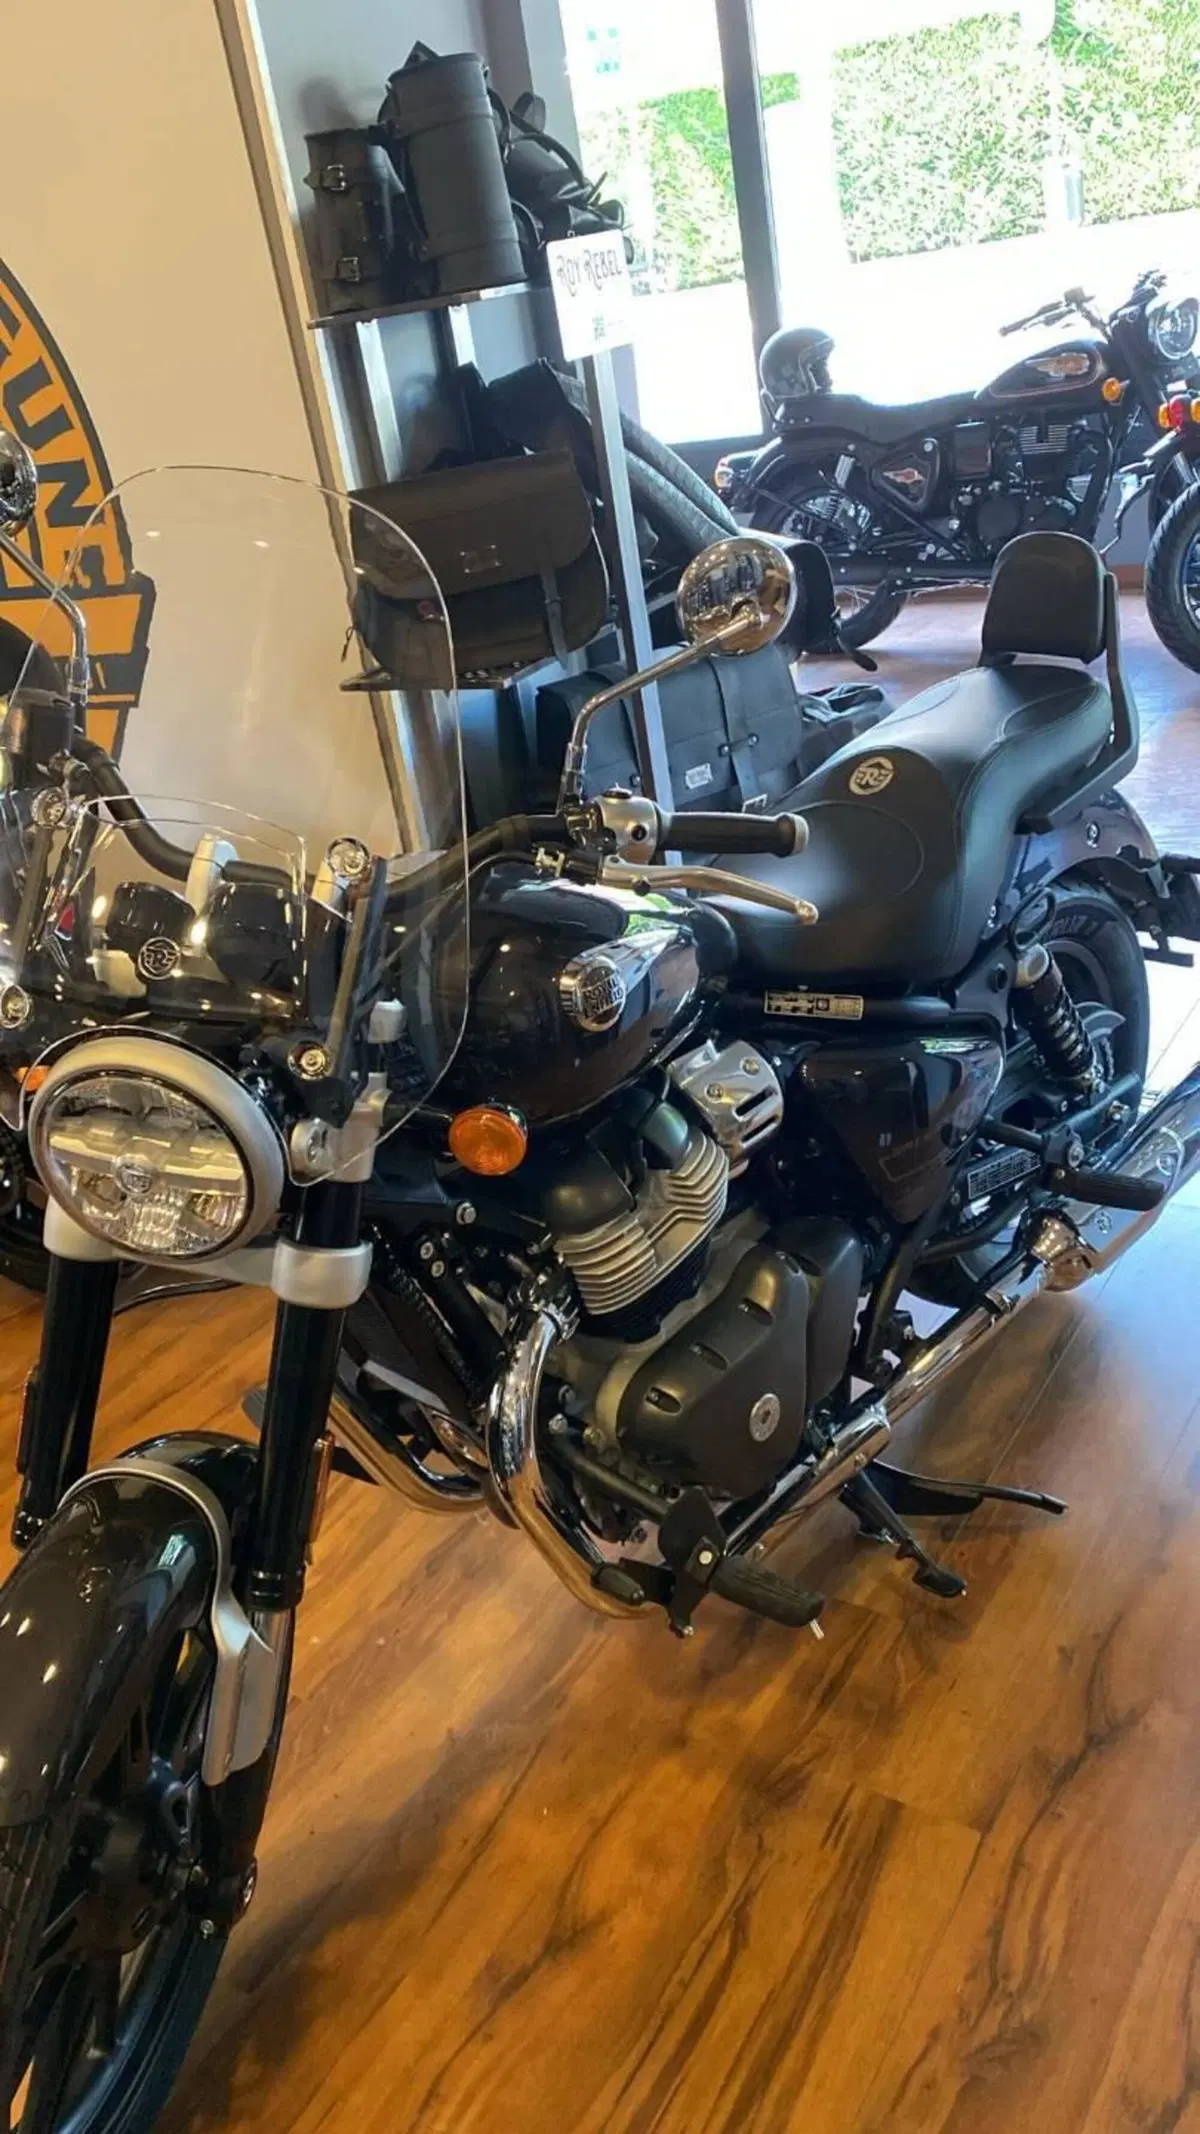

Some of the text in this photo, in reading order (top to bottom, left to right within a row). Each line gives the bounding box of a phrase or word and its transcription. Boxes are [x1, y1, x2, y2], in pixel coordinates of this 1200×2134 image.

[556, 248, 622, 297] ROY REBEL
[0, 293, 105, 527] UN
